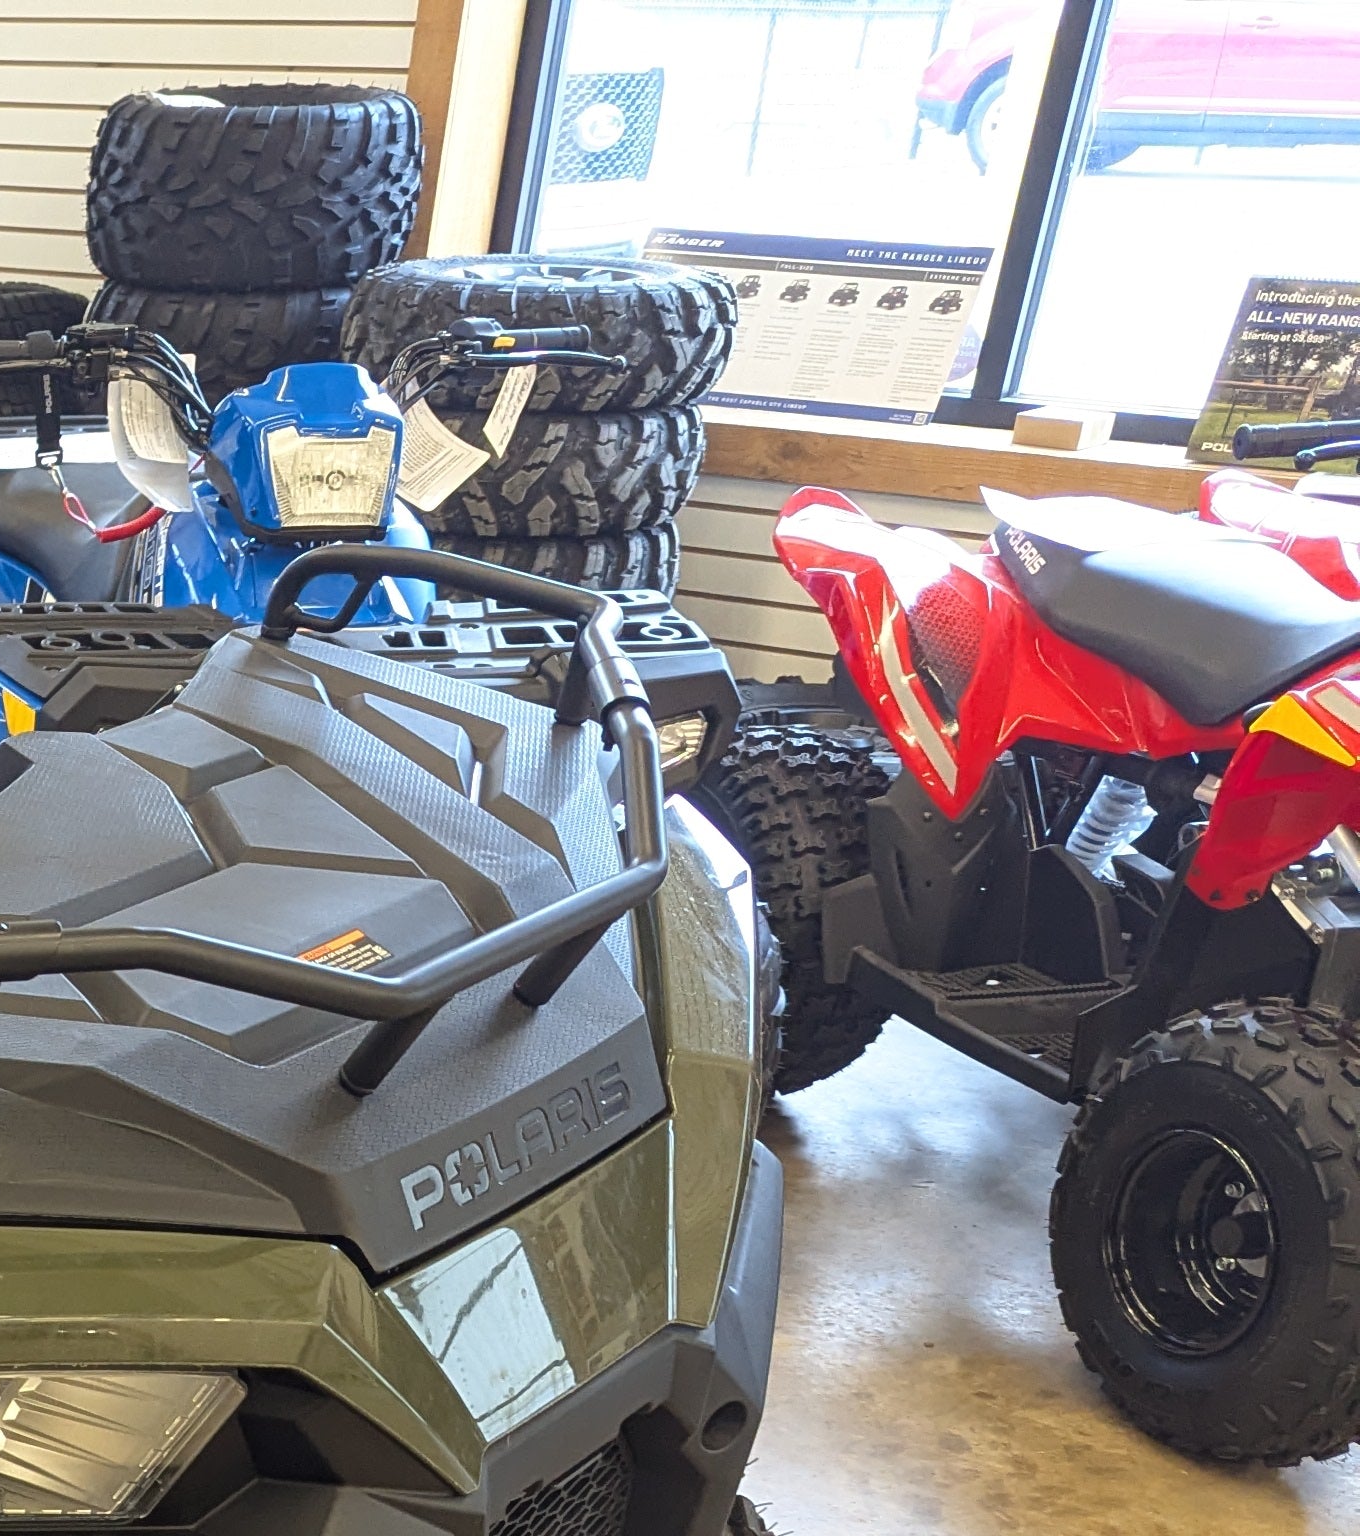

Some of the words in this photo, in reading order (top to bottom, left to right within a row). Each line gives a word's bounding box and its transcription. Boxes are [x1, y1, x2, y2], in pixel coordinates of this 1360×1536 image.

[652, 236, 724, 248] RANGER
[846, 249, 874, 258] MEET
[878, 251, 898, 260] THE
[901, 252, 944, 263] RANGER
[947, 254, 987, 265] LINEUP
[1255, 289, 1335, 308] Introducing
[1337, 293, 1360, 307] the
[1246, 310, 1318, 325] ALL-NEW
[1318, 314, 1360, 328] RANG
[1241, 330, 1279, 343] Starting
[1280, 332, 1291, 341] at
[1005, 526, 1048, 576] POLARIS
[400, 1061, 630, 1232] POLARIS
